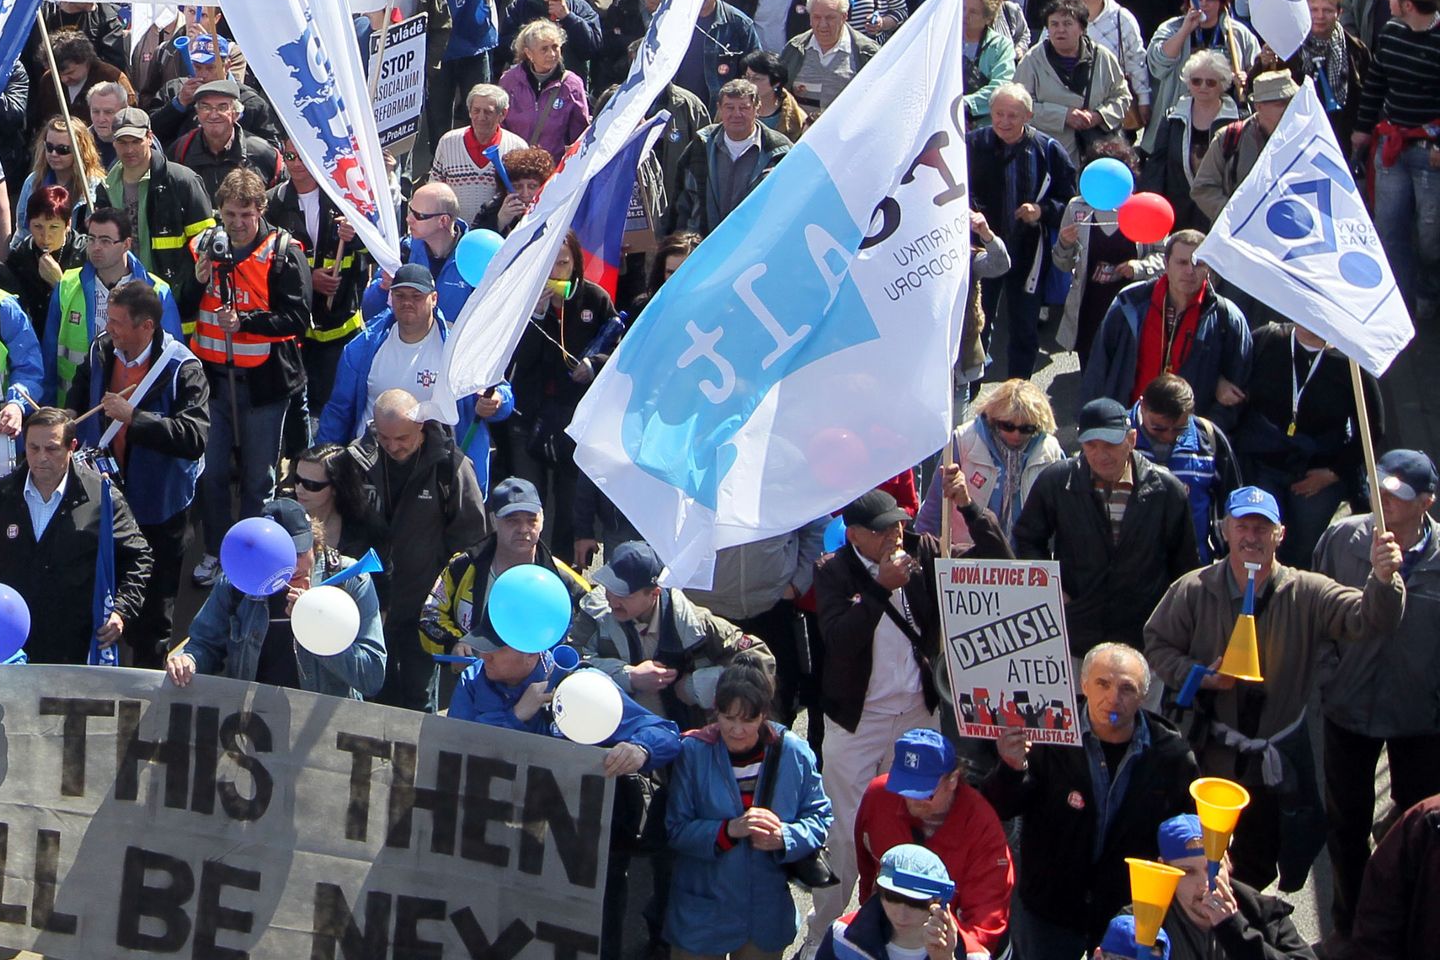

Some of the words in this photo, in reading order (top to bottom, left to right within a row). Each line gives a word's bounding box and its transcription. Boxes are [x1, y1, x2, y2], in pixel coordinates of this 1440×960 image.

[392, 22, 423, 44] vládě
[381, 50, 415, 80] STOP
[374, 92, 417, 123] REFORMÁM
[951, 563, 981, 585] NOVÁ
[982, 569, 1025, 586] LEVICE
[945, 590, 1001, 616] TADY!
[952, 606, 1060, 667] DEMISI!
[1020, 656, 1068, 685] TEĎ!
[39, 696, 273, 821] THIS
[337, 732, 605, 890] THEN
[116, 845, 261, 960] BE
